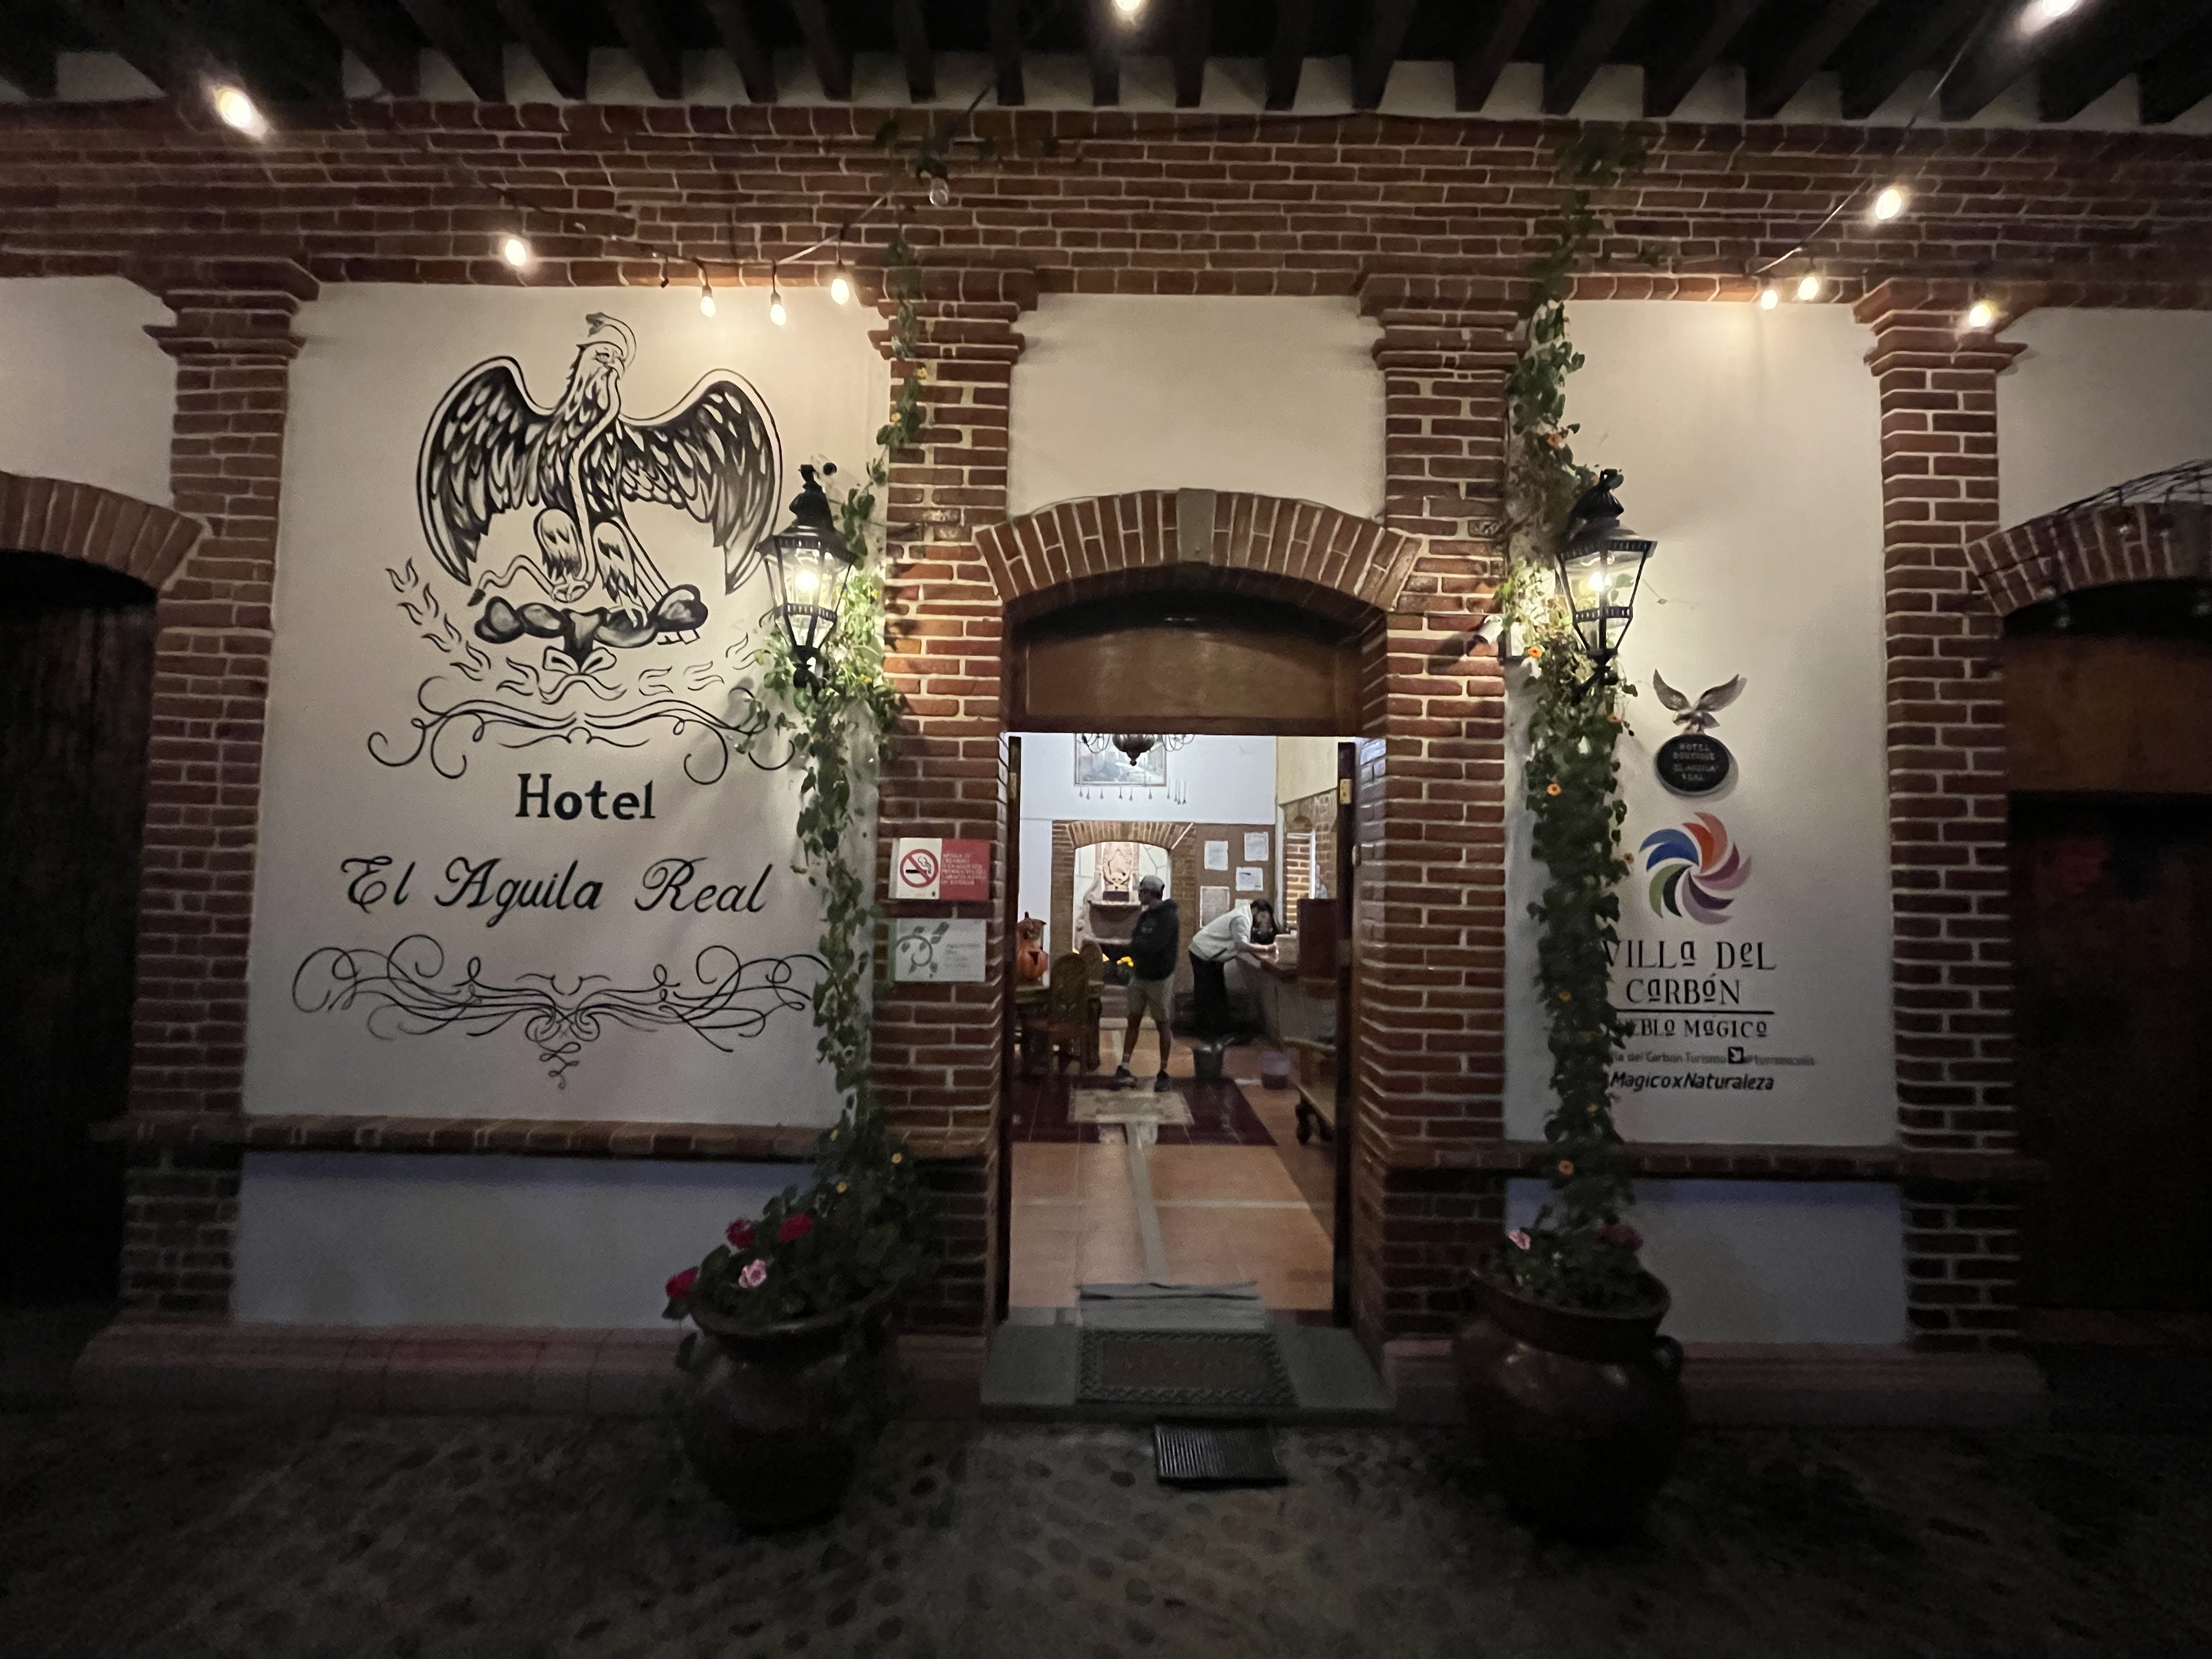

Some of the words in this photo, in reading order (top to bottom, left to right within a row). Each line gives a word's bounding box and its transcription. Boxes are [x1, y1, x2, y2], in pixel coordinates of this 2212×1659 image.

[515, 773, 656, 820] Hotel
[340, 856, 416, 913] El
[435, 856, 603, 928] Aguila
[634, 857, 773, 913] Real
